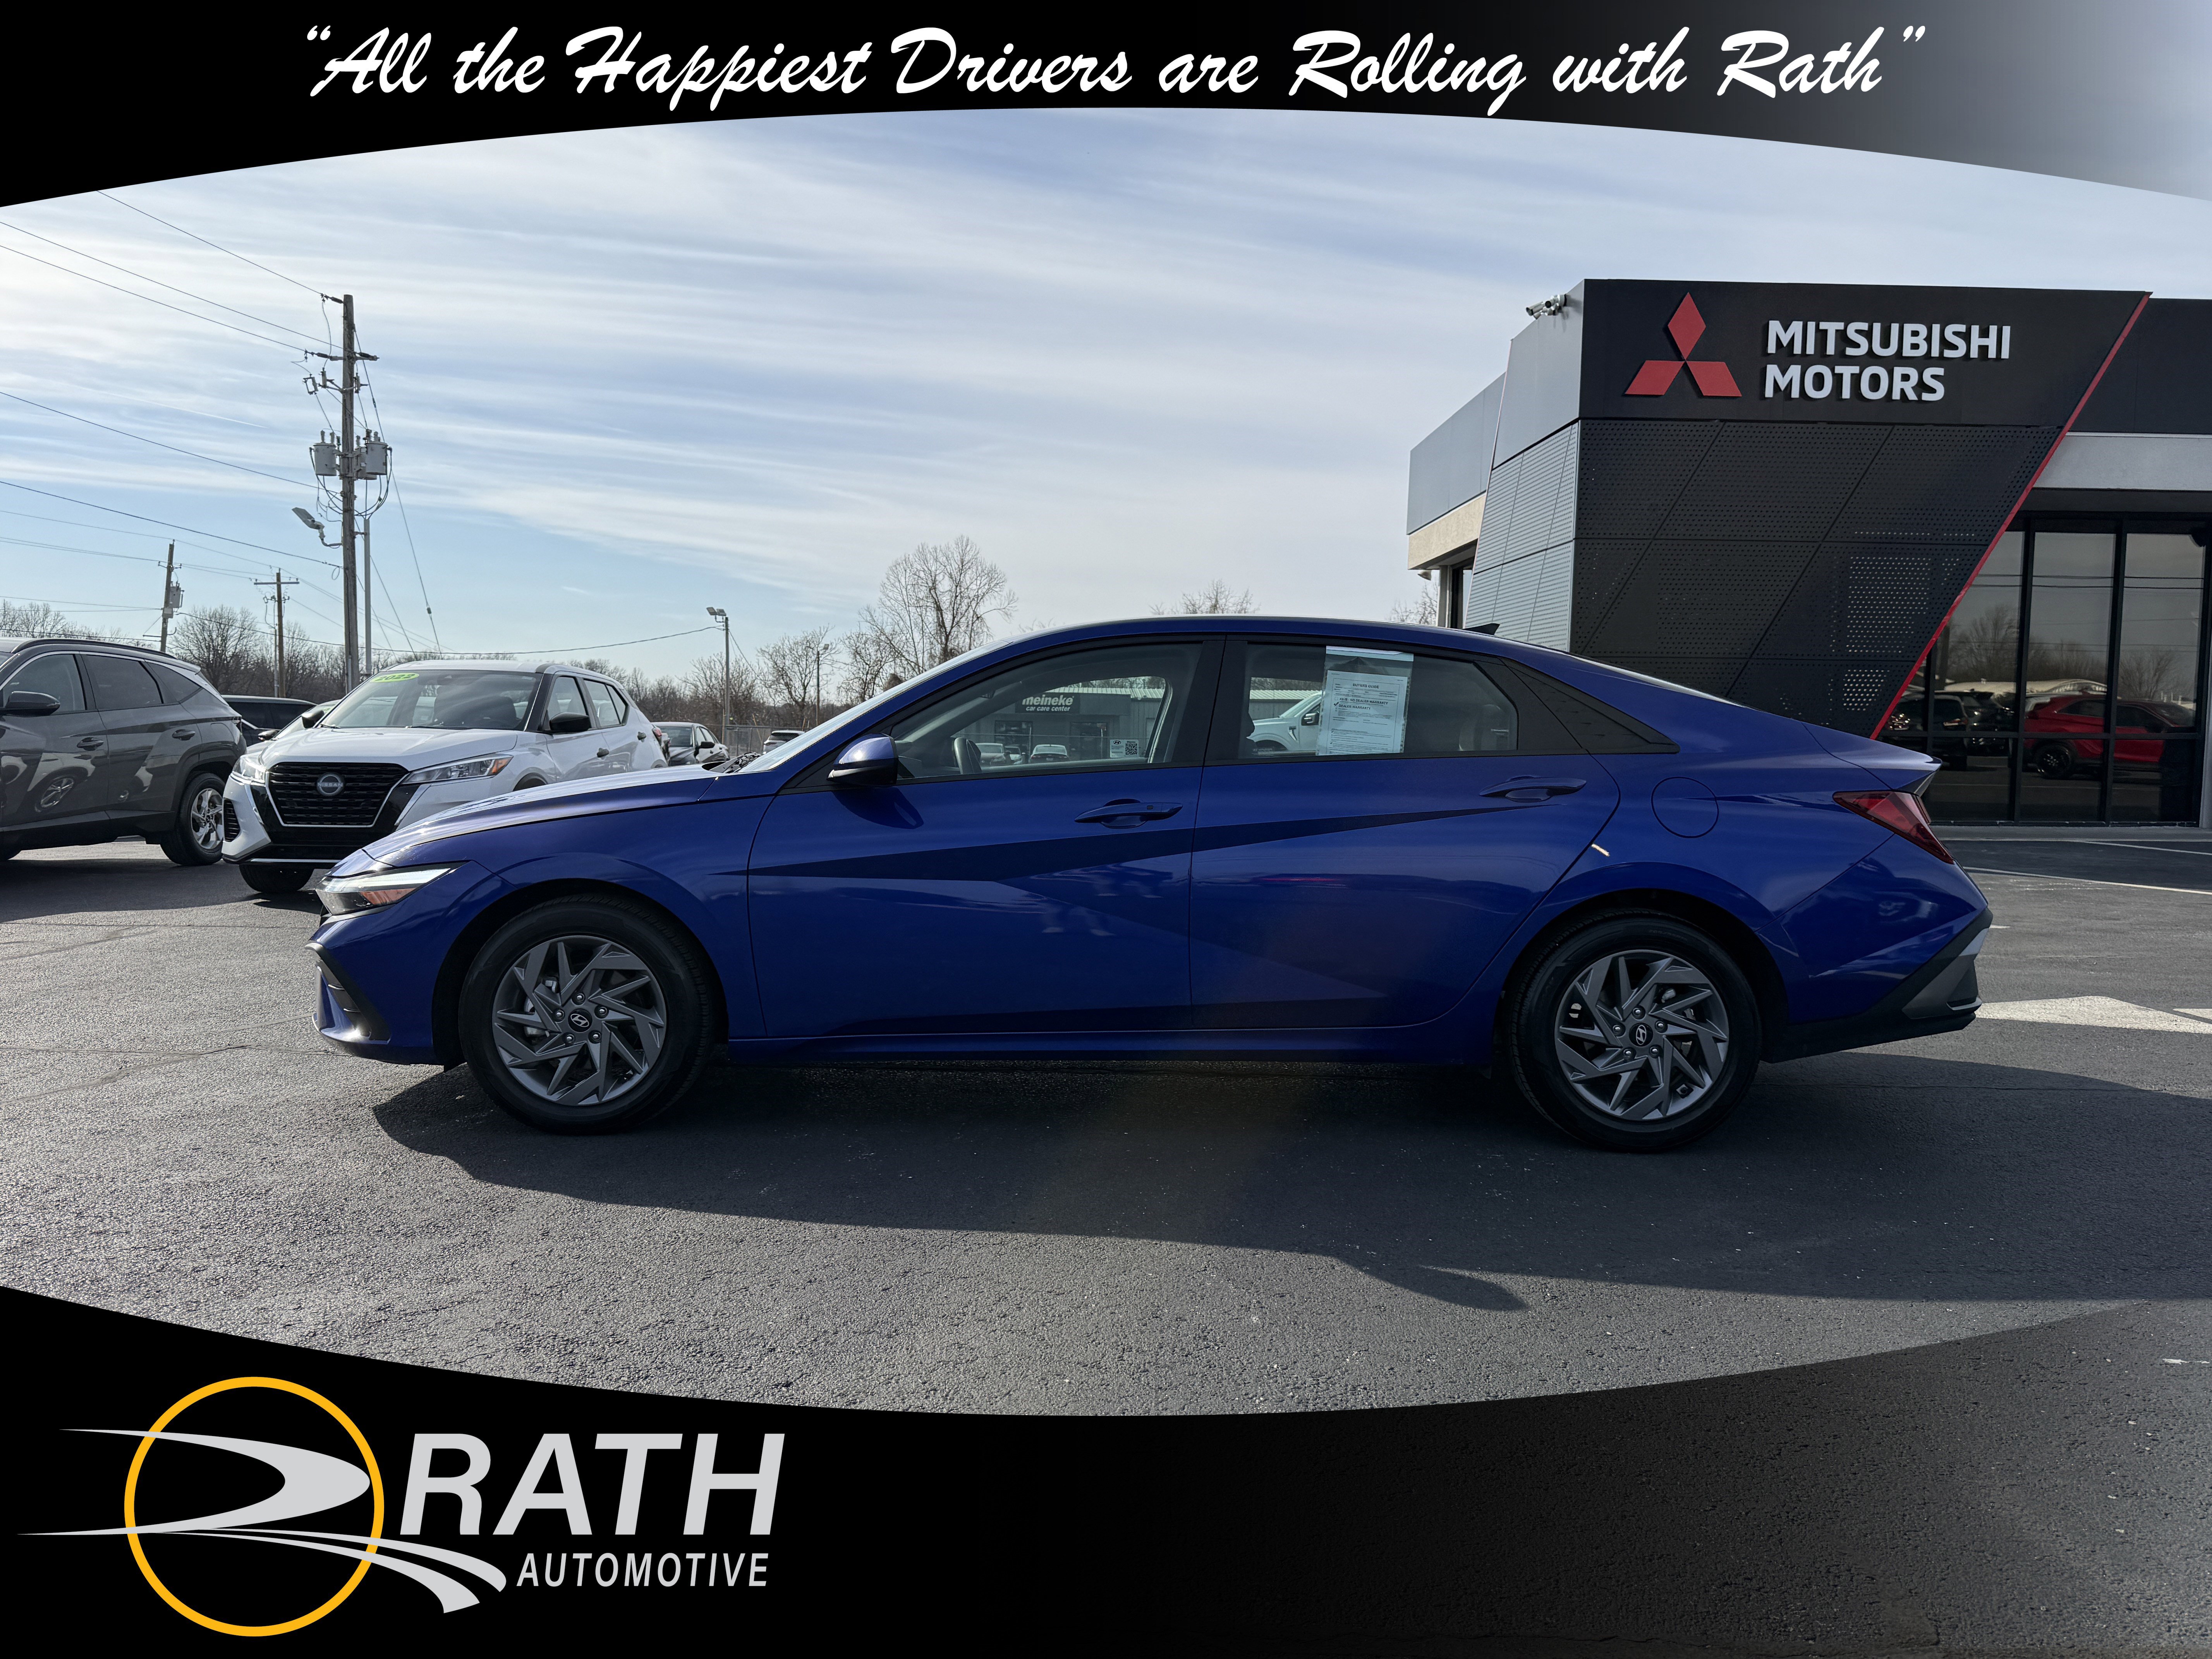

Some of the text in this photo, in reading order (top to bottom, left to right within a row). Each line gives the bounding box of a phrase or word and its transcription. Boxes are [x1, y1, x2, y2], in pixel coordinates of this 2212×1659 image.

[1767, 320, 2011, 359] MITSUBISHI
[1764, 364, 1945, 401] MOTORS
[1022, 694, 1073, 706] meineke
